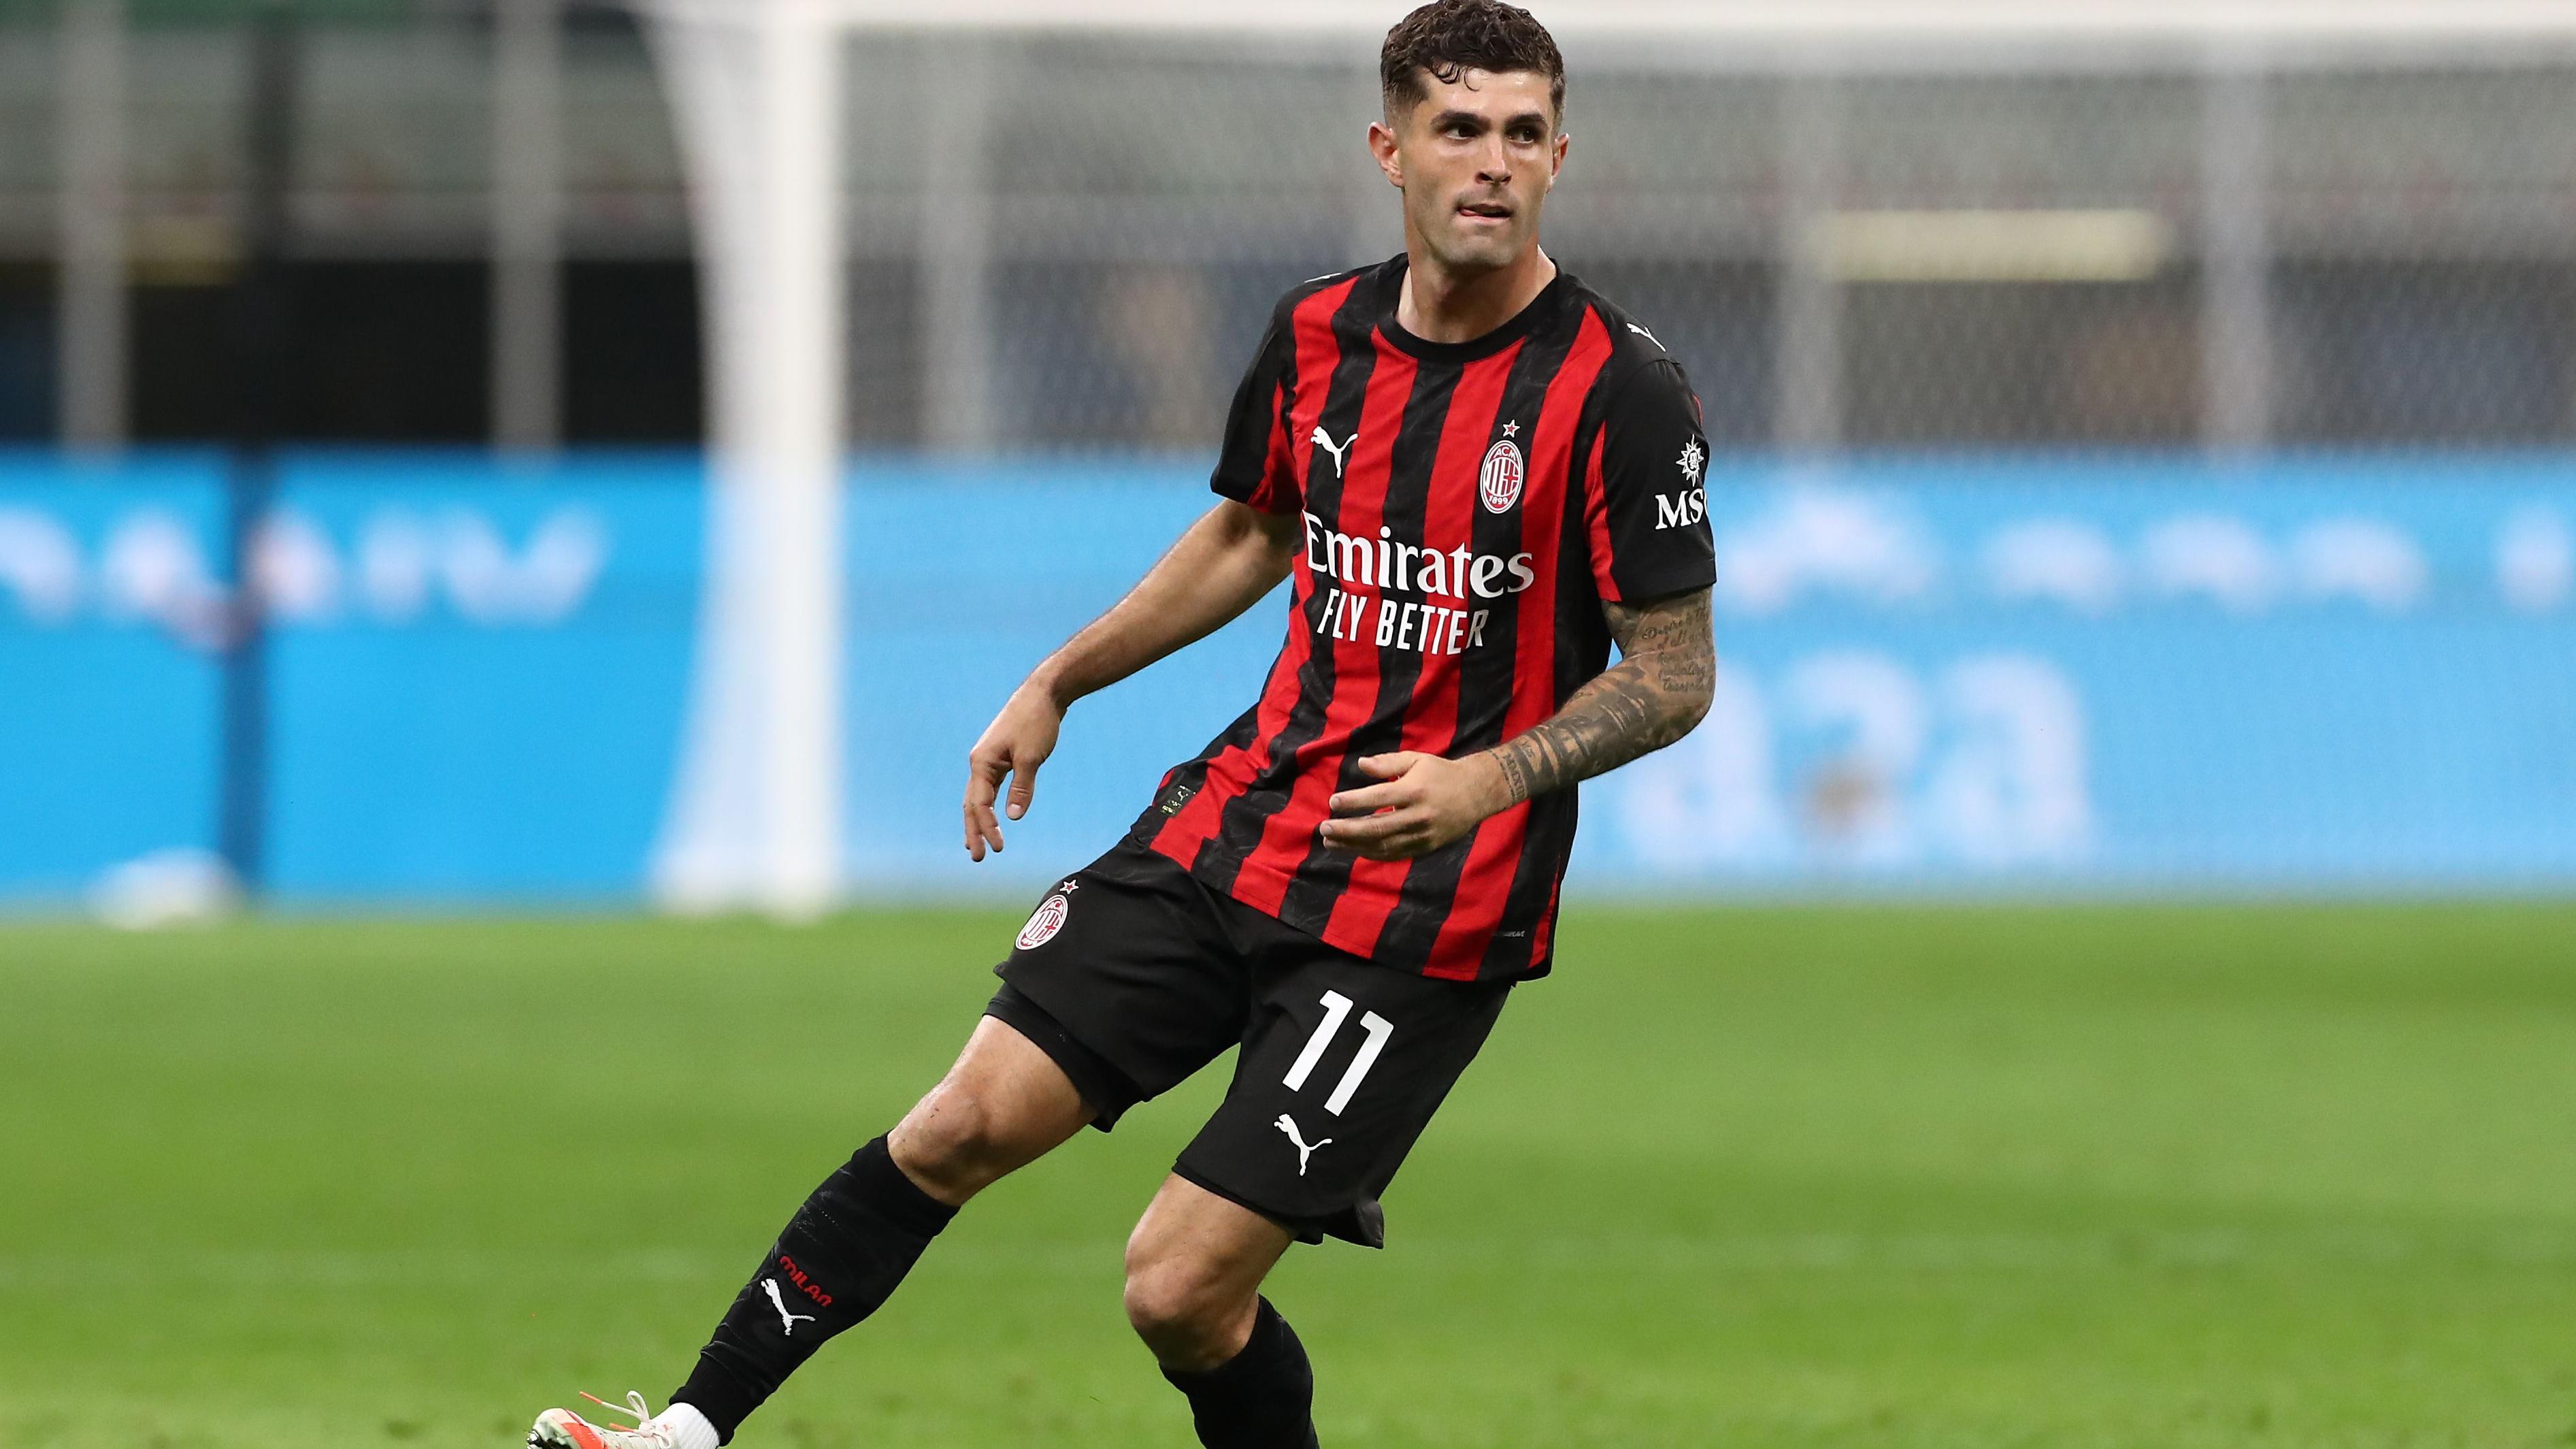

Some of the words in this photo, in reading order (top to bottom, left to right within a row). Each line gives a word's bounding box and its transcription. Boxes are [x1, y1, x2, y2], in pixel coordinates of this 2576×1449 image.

[1493, 446, 1516, 461] ACM
[1489, 495, 1508, 505] 1899
[1655, 488, 1707, 530] MS
[1302, 508, 1534, 598] Emirates
[1317, 588, 1368, 642] FLY
[1375, 599, 1489, 655] BETTER
[1282, 990, 1394, 1116] 11
